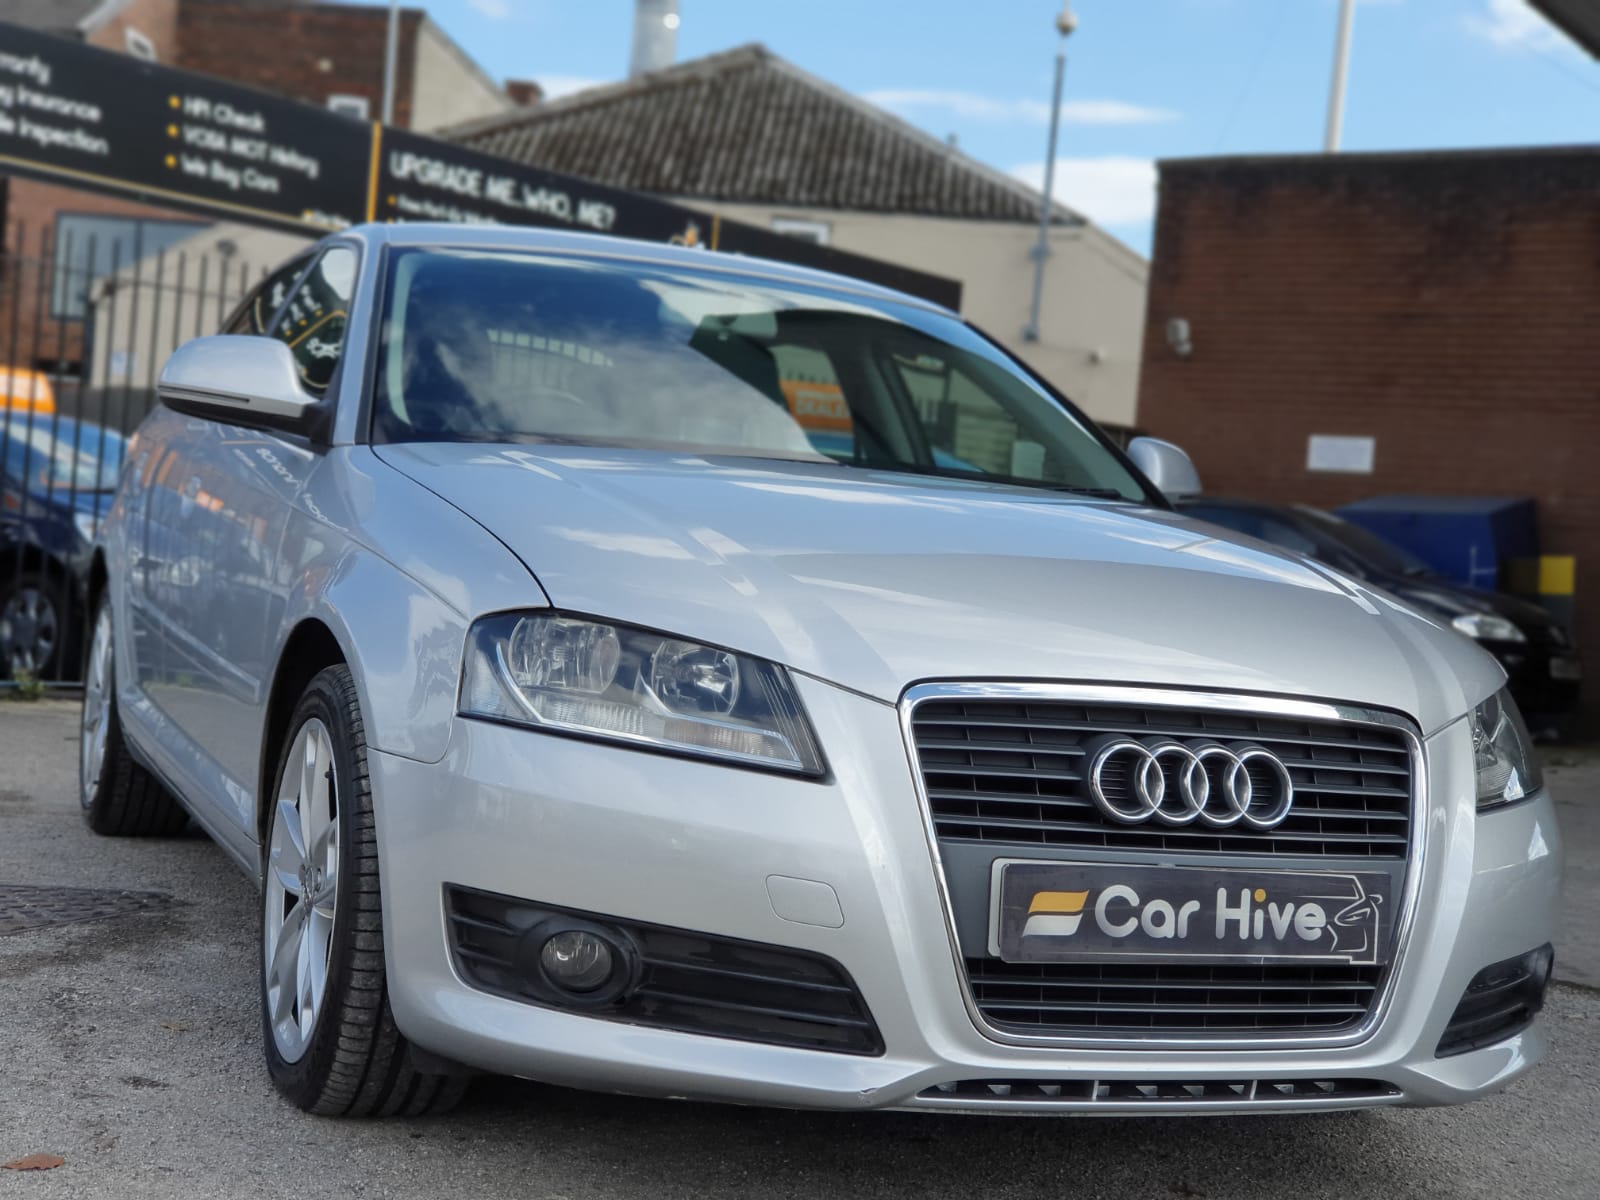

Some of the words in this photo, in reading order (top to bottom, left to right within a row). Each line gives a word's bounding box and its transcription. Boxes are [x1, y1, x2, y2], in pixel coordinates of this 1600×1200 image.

[17, 84, 102, 122] Insurance
[213, 103, 265, 132] Check
[19, 117, 109, 155] Inspection
[242, 168, 280, 193] Cars
[389, 150, 483, 198] UPGRADE
[577, 200, 617, 230] ME?
[1094, 884, 1200, 940] Car
[1216, 887, 1327, 941] Hive
